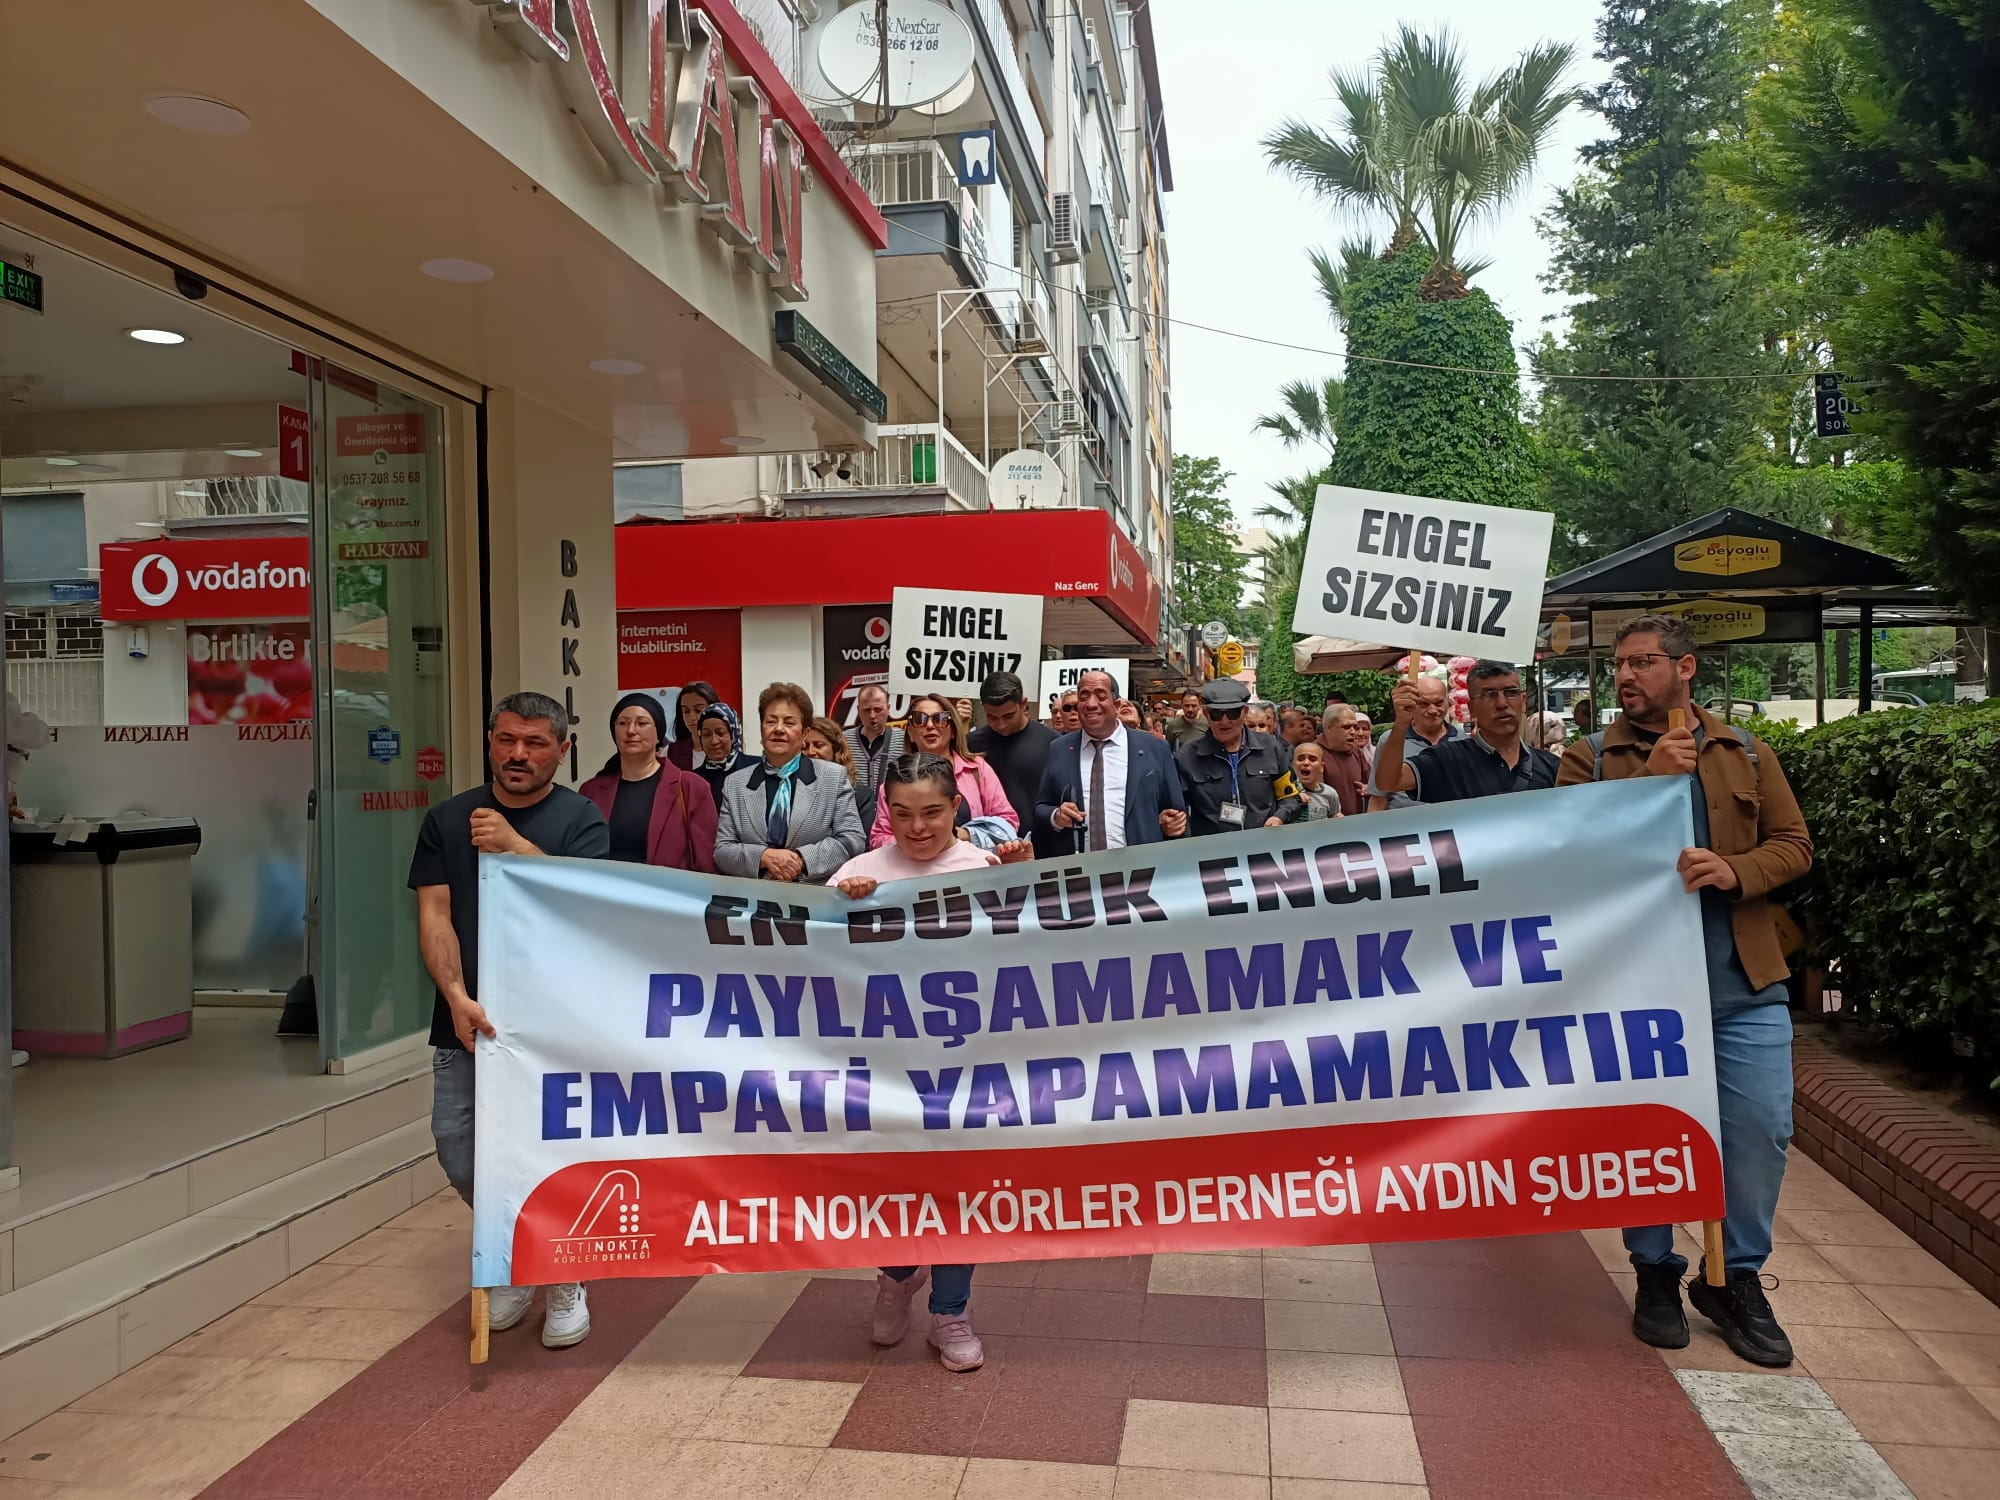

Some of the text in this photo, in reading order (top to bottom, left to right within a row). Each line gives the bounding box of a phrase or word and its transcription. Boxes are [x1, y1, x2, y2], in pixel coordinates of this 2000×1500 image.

[895, 17, 942, 35] NextStar
[856, 33, 881, 48] 0536
[887, 38, 906, 51] 266
[910, 40, 922, 51] 12
[926, 39, 939, 51] 08
[7, 269, 36, 291] EXIT
[283, 415, 309, 432] KASA
[291, 435, 304, 472] 1
[343, 471, 421, 485] 0537 208 56 68
[1008, 464, 1043, 473] BALIM
[1356, 508, 1492, 570] ENGEL
[344, 542, 421, 558] HALKTAN
[1054, 581, 1100, 592] Naz Genç
[621, 623, 688, 637] internetini
[923, 604, 1008, 641] ENGEL
[191, 633, 296, 663] Birlikte
[620, 640, 707, 654] bulabilirsiniz.
[704, 894, 810, 946] EN
[1198, 828, 1479, 917] ENGEL
[645, 914, 1562, 1049] PAYLAŞAMAMAK VE
[541, 1008, 1690, 1141] EMPATİ YAPAMAMAKTIR
[684, 1133, 1697, 1247] ALTI NOKTA KÖRLER DERNEĞİ AYDIN ŞUBESİ
